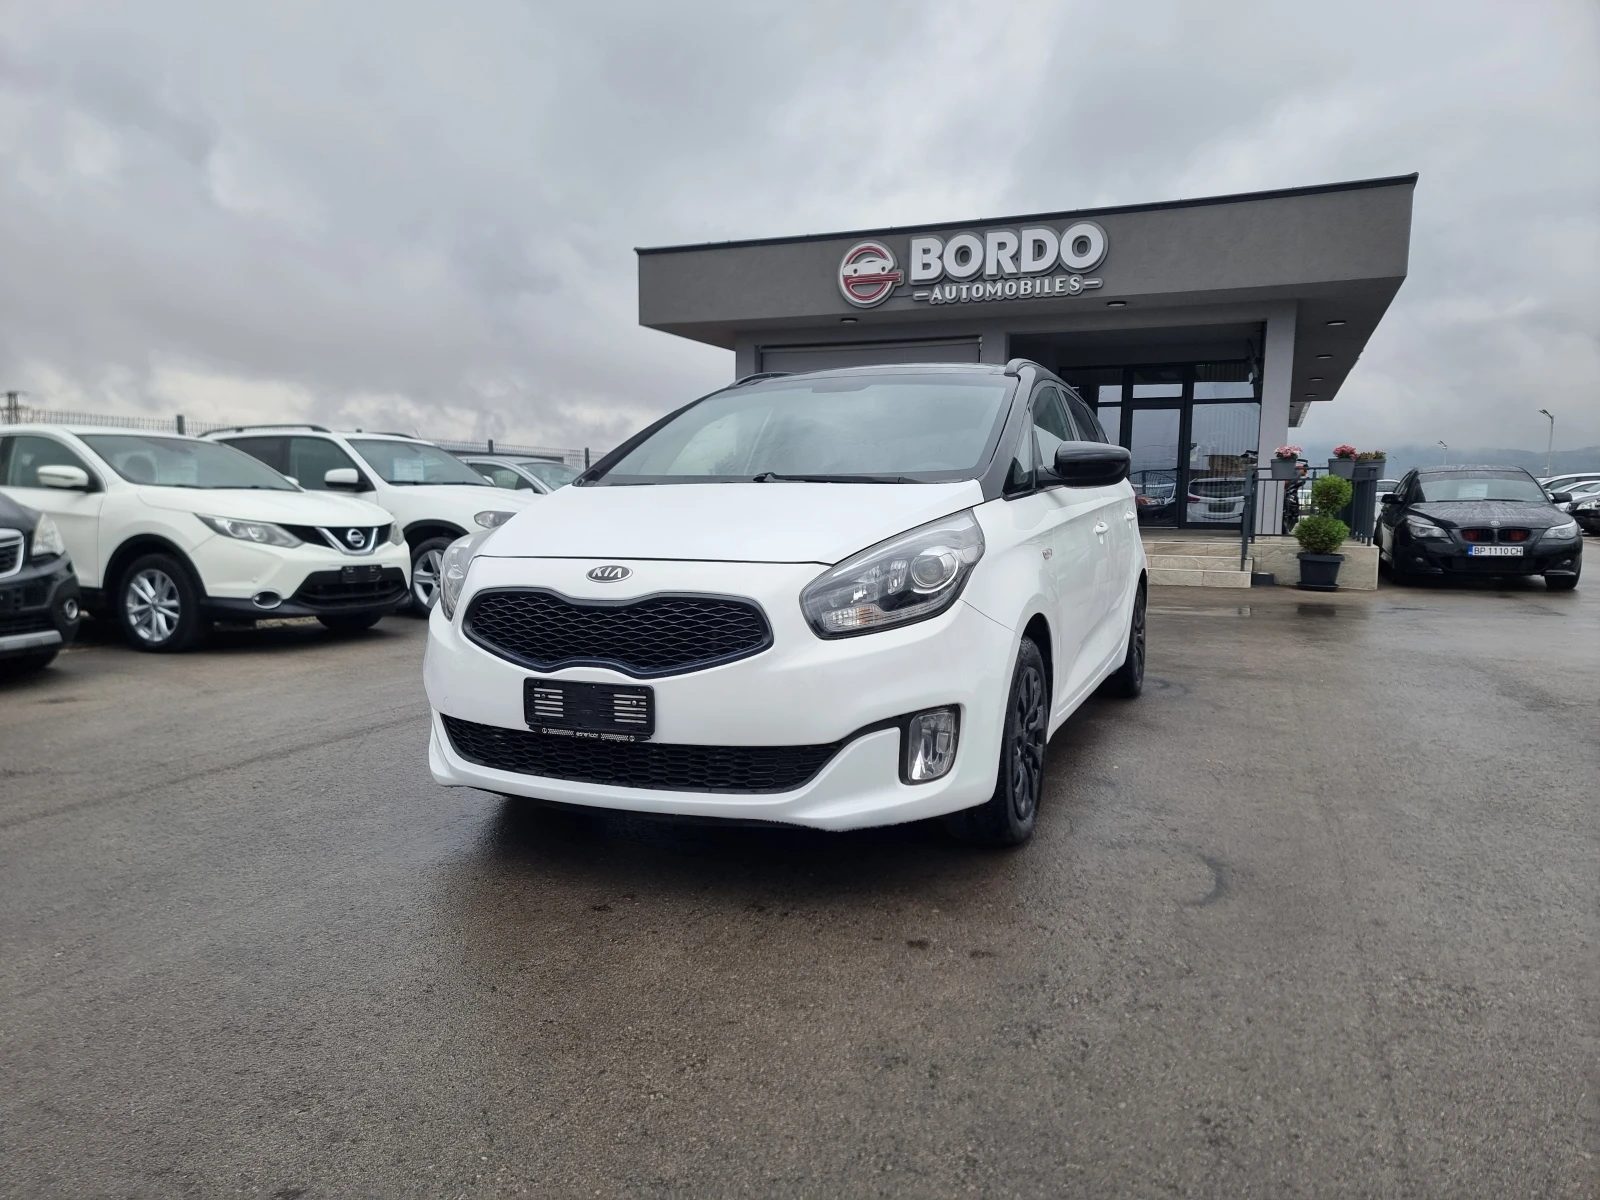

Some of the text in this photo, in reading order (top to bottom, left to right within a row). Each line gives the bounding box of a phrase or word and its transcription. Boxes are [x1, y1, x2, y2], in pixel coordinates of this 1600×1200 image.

[910, 223, 1105, 281] BORDO
[931, 276, 1081, 300] AUTOMOBILES
[1474, 547, 1522, 555] BP 1110 CH
[591, 566, 623, 578] KIA
